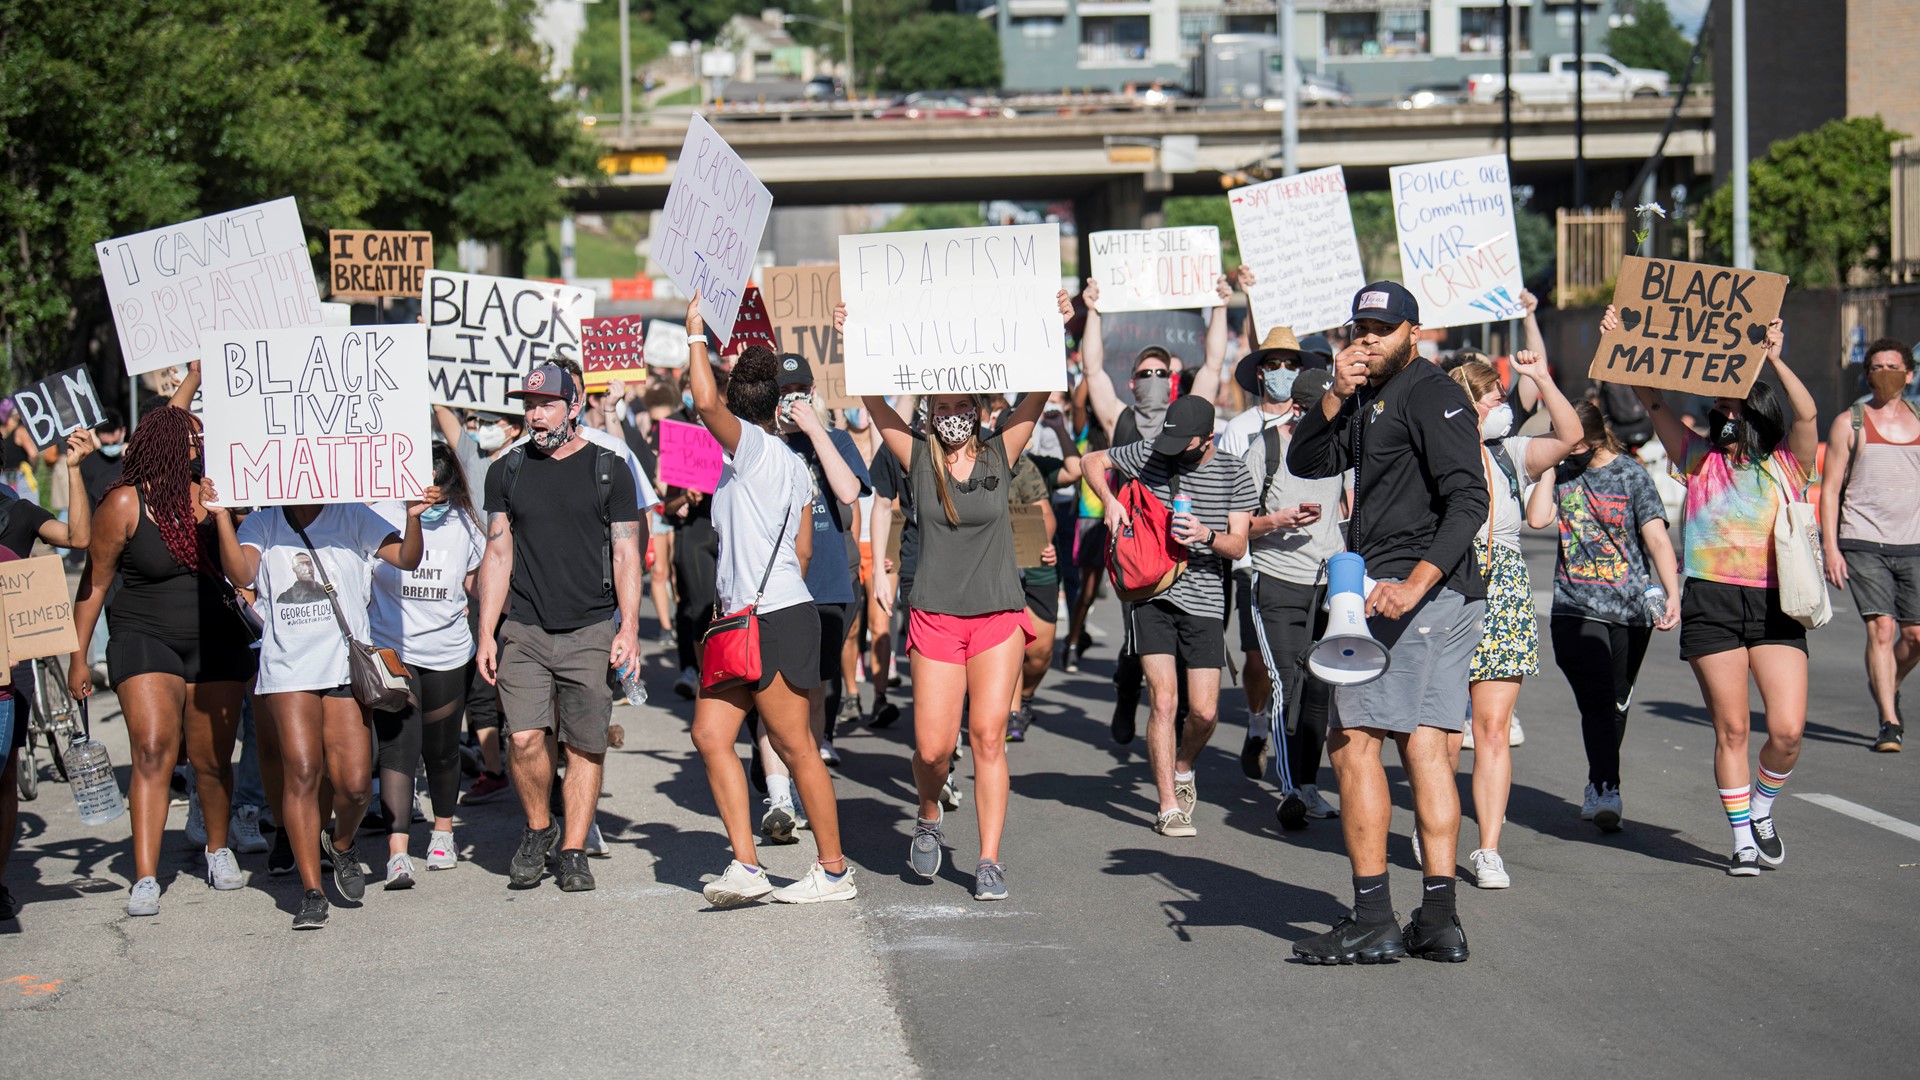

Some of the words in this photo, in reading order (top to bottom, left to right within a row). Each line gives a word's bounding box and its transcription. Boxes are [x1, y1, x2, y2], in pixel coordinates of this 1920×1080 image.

[693, 136, 756, 236] RACISM
[1245, 184, 1271, 208] SAY
[1303, 171, 1347, 196] NAMES
[1479, 165, 1507, 184] are
[670, 177, 710, 243] ISN'T
[706, 215, 748, 281] BORN
[1398, 193, 1505, 232] Committing
[154, 210, 266, 277] CAN'T
[333, 235, 354, 259] I
[363, 234, 430, 262] CAN'T
[1092, 233, 1150, 255] WHITE
[1157, 228, 1216, 252] SILE
[1403, 225, 1476, 270] WAR
[334, 264, 424, 292] BREATHE
[659, 226, 690, 275] IT'S
[690, 251, 737, 325] TAUGHT
[1110, 268, 1126, 285] IS
[1124, 255, 1218, 297] OLENCE
[1421, 237, 1516, 308] CRIME
[1641, 261, 1756, 313] BLACK
[430, 276, 583, 345] BLACK
[772, 272, 841, 318] BLAC
[587, 326, 637, 338] BLACK
[590, 340, 637, 352] LIVES
[774, 325, 843, 365] LIVE
[1642, 305, 1743, 350] LIVES
[224, 332, 399, 398] BLACK
[590, 352, 639, 363] MATTER
[893, 362, 1009, 392] #eracism
[1607, 344, 1747, 385] MATTER
[428, 367, 524, 406] MATT
[14, 367, 105, 447] BLM
[265, 394, 384, 436] LIVES
[229, 432, 424, 501] MATTER
[411, 568, 443, 580] CAN'T
[425, 550, 429, 561] I
[280, 605, 311, 621] GEORGE
[313, 603, 336, 617] FLOY
[402, 586, 448, 599] BREATHE
[9, 602, 71, 635] FILMED?
